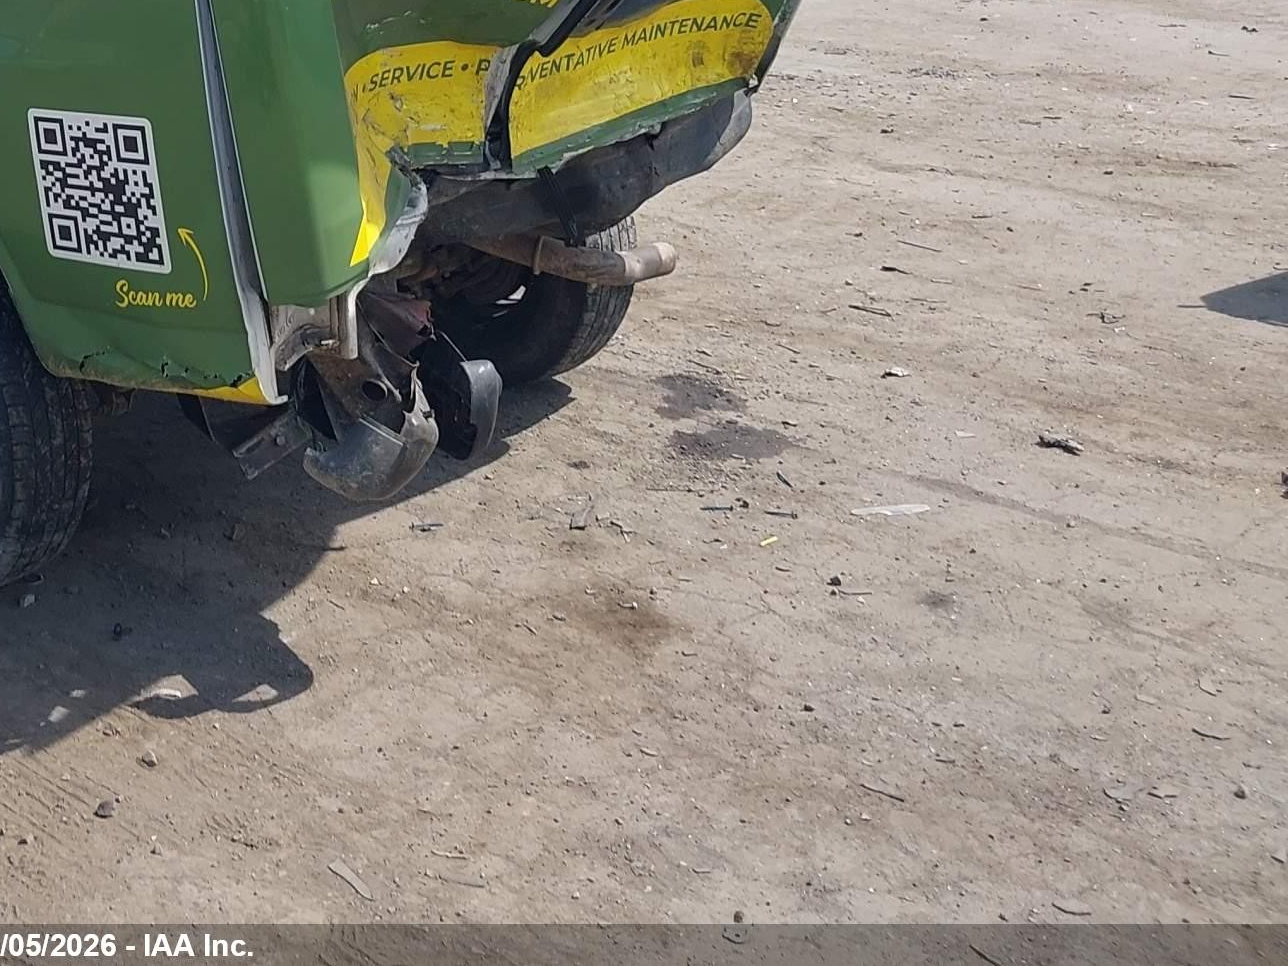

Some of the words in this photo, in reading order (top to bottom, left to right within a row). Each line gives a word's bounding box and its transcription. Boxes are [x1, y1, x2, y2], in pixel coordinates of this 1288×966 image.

[622, 12, 762, 49] MAINTENANCE
[369, 60, 456, 92] SERVICE
[115, 279, 163, 308] Scan
[165, 292, 197, 308] me
